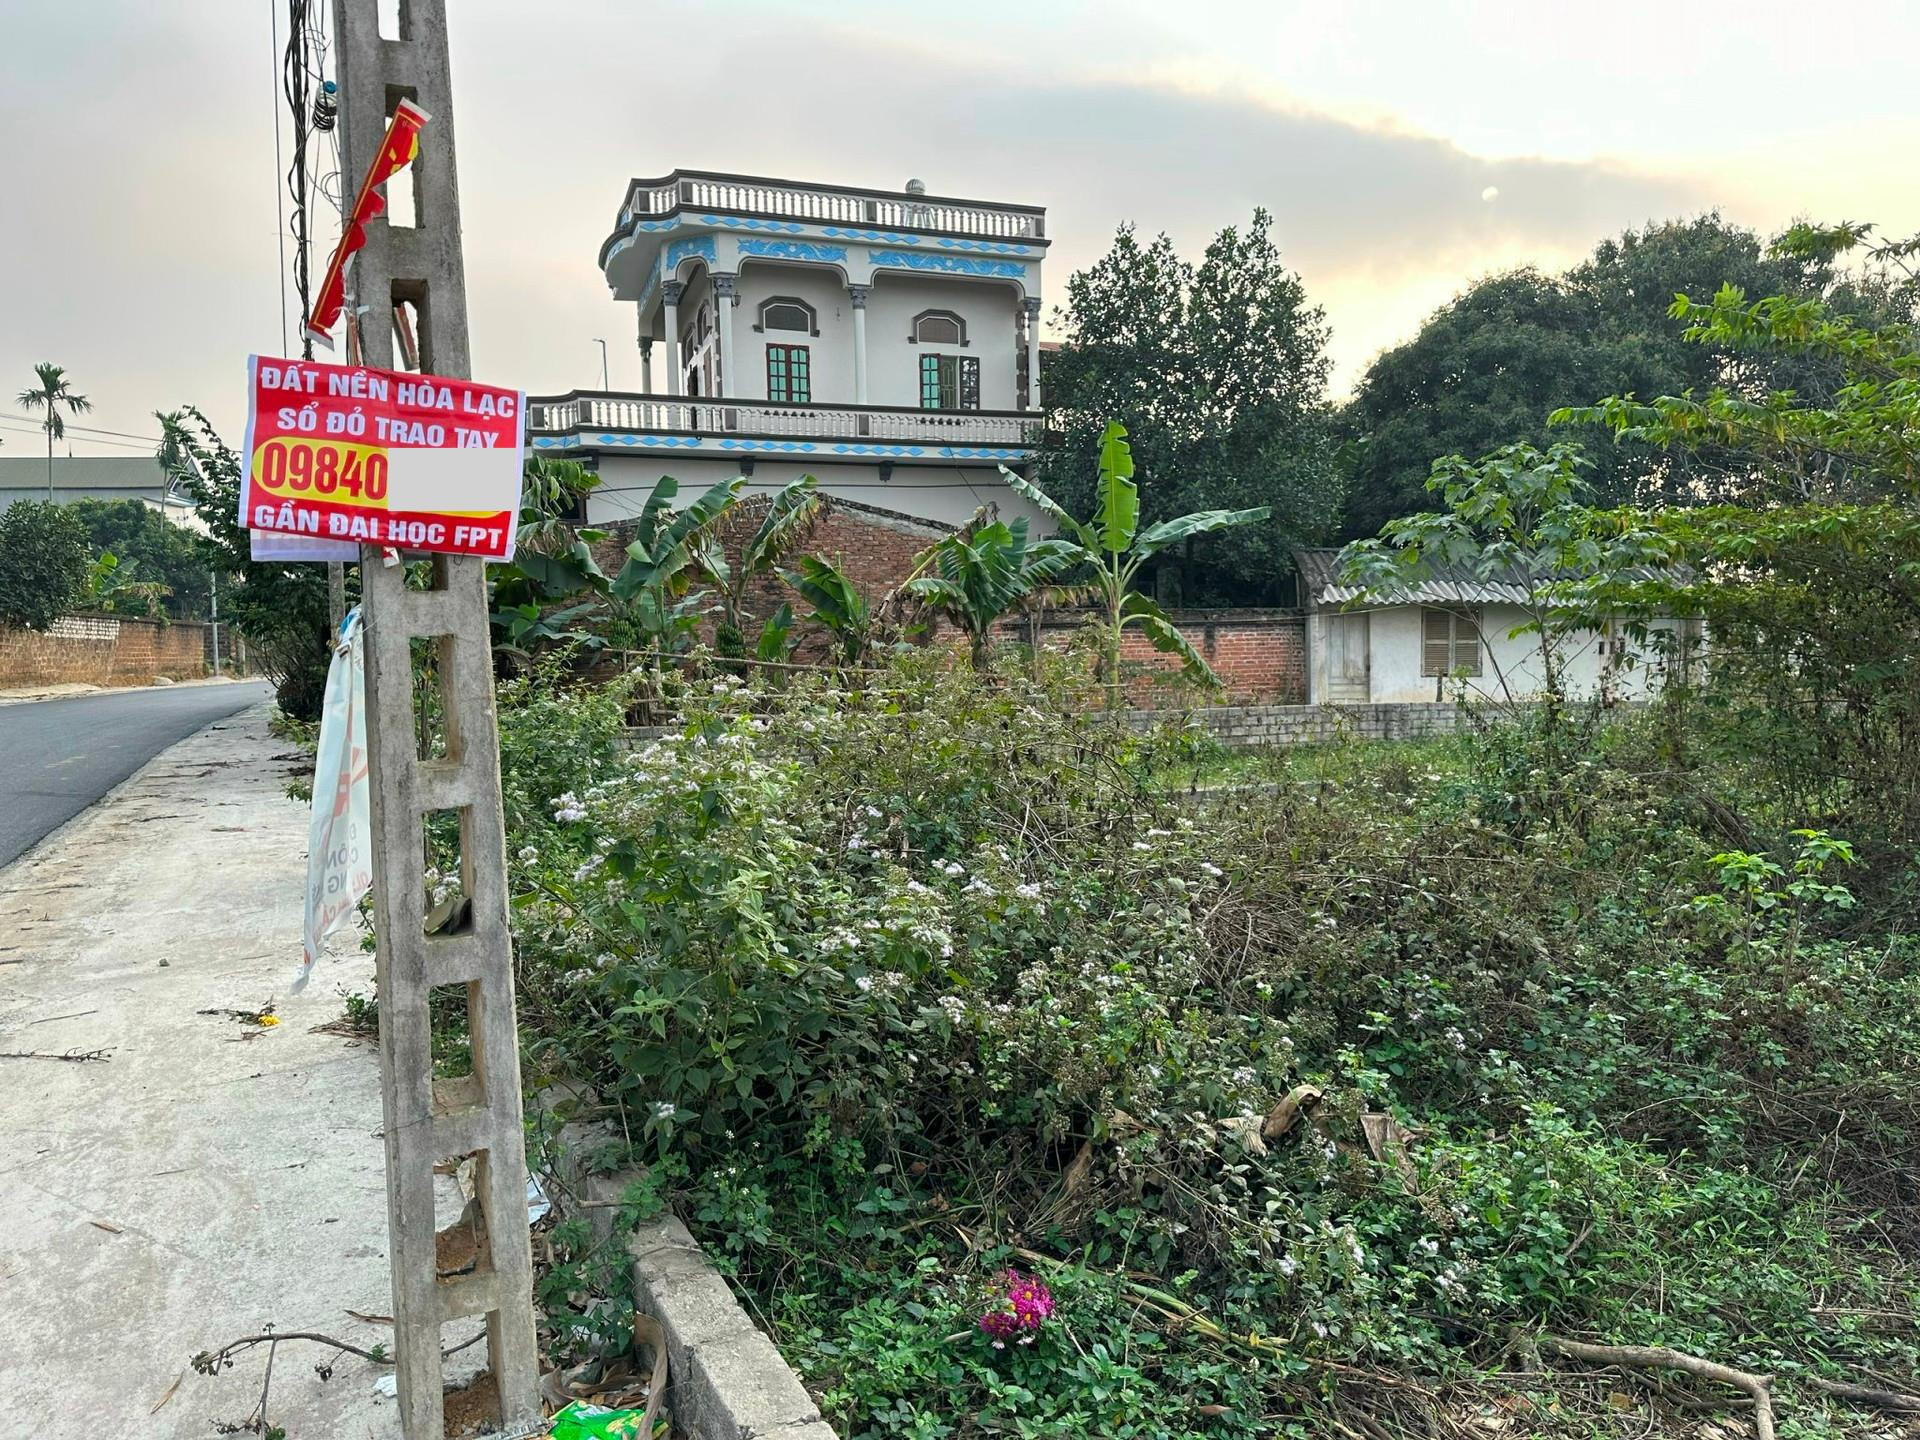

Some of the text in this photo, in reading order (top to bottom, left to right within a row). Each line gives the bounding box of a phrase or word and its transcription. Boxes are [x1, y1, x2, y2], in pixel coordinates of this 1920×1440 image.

[261, 364, 514, 420] ĐẤT NỀN HÒA LẠC
[277, 401, 499, 448] SỔ ĐỎ TRAO TAY
[254, 500, 503, 549] GẦN ĐẠI HỌC FPT
